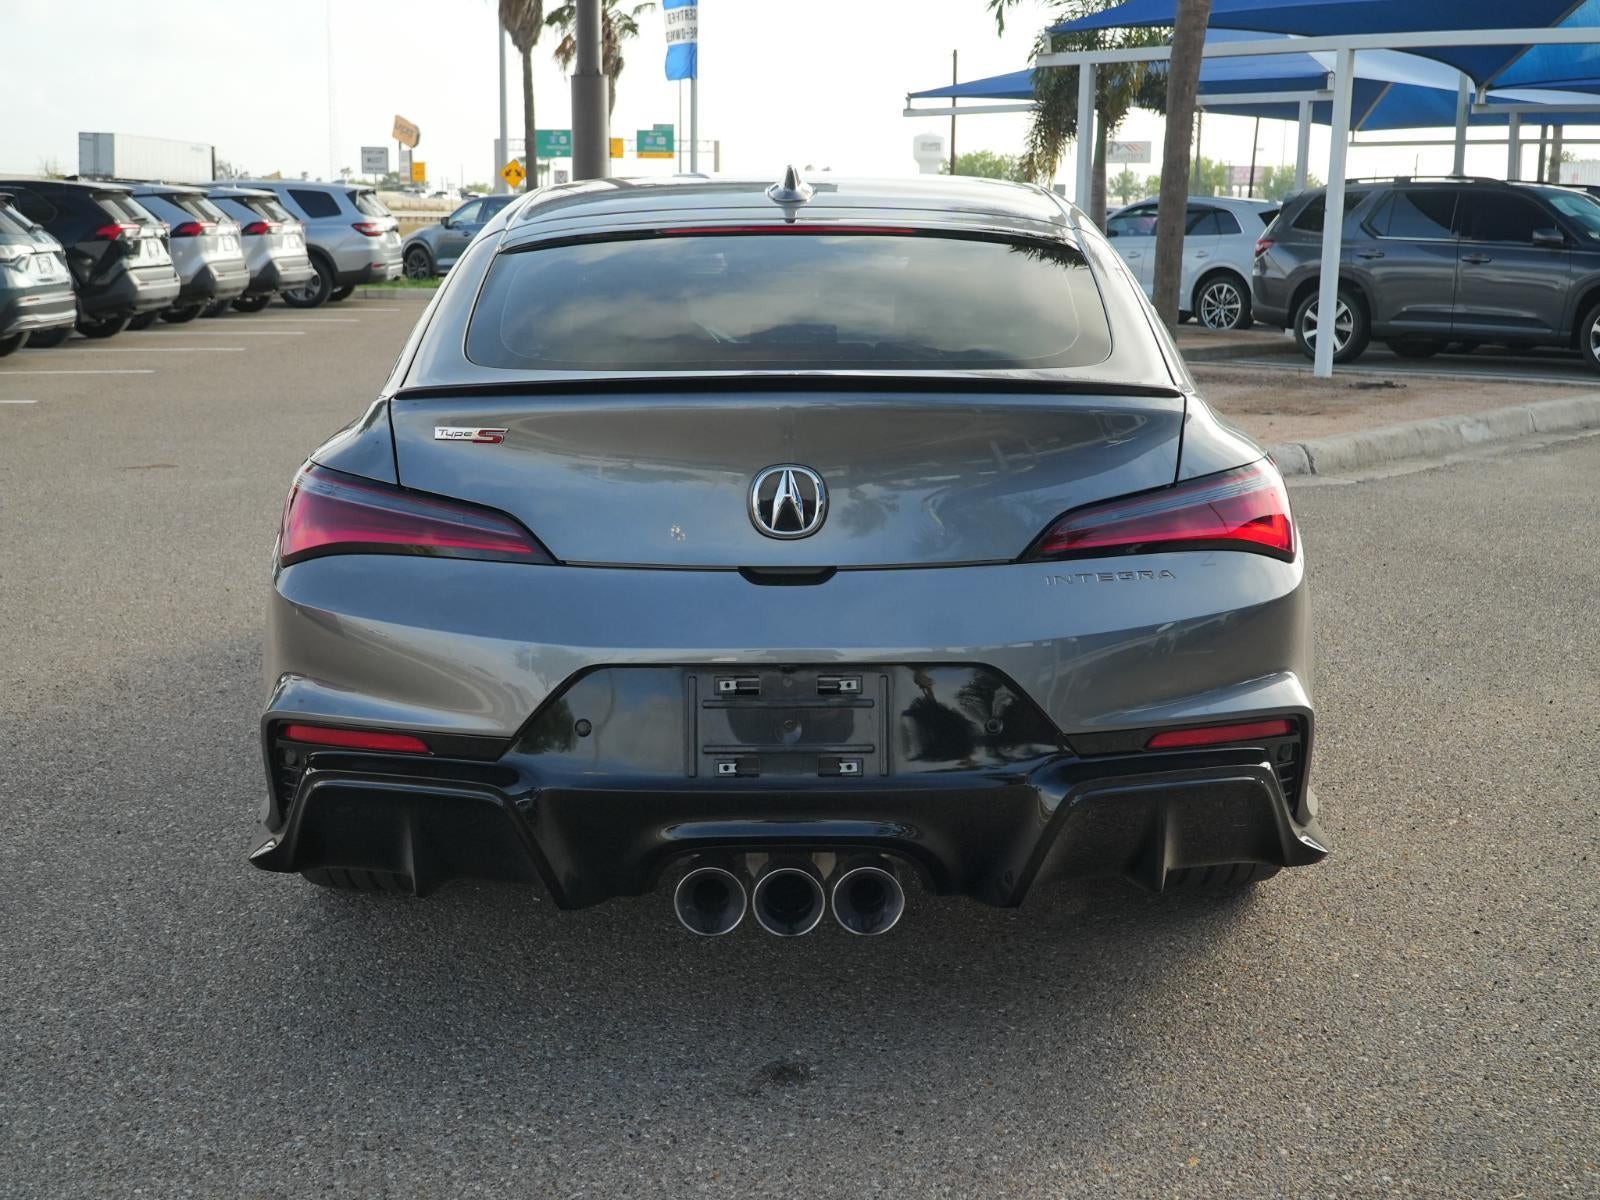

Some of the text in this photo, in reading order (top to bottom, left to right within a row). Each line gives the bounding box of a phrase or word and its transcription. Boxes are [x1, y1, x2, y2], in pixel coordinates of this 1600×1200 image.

[438, 427, 509, 444] Type S
[1045, 569, 1177, 586] INTEGRA
